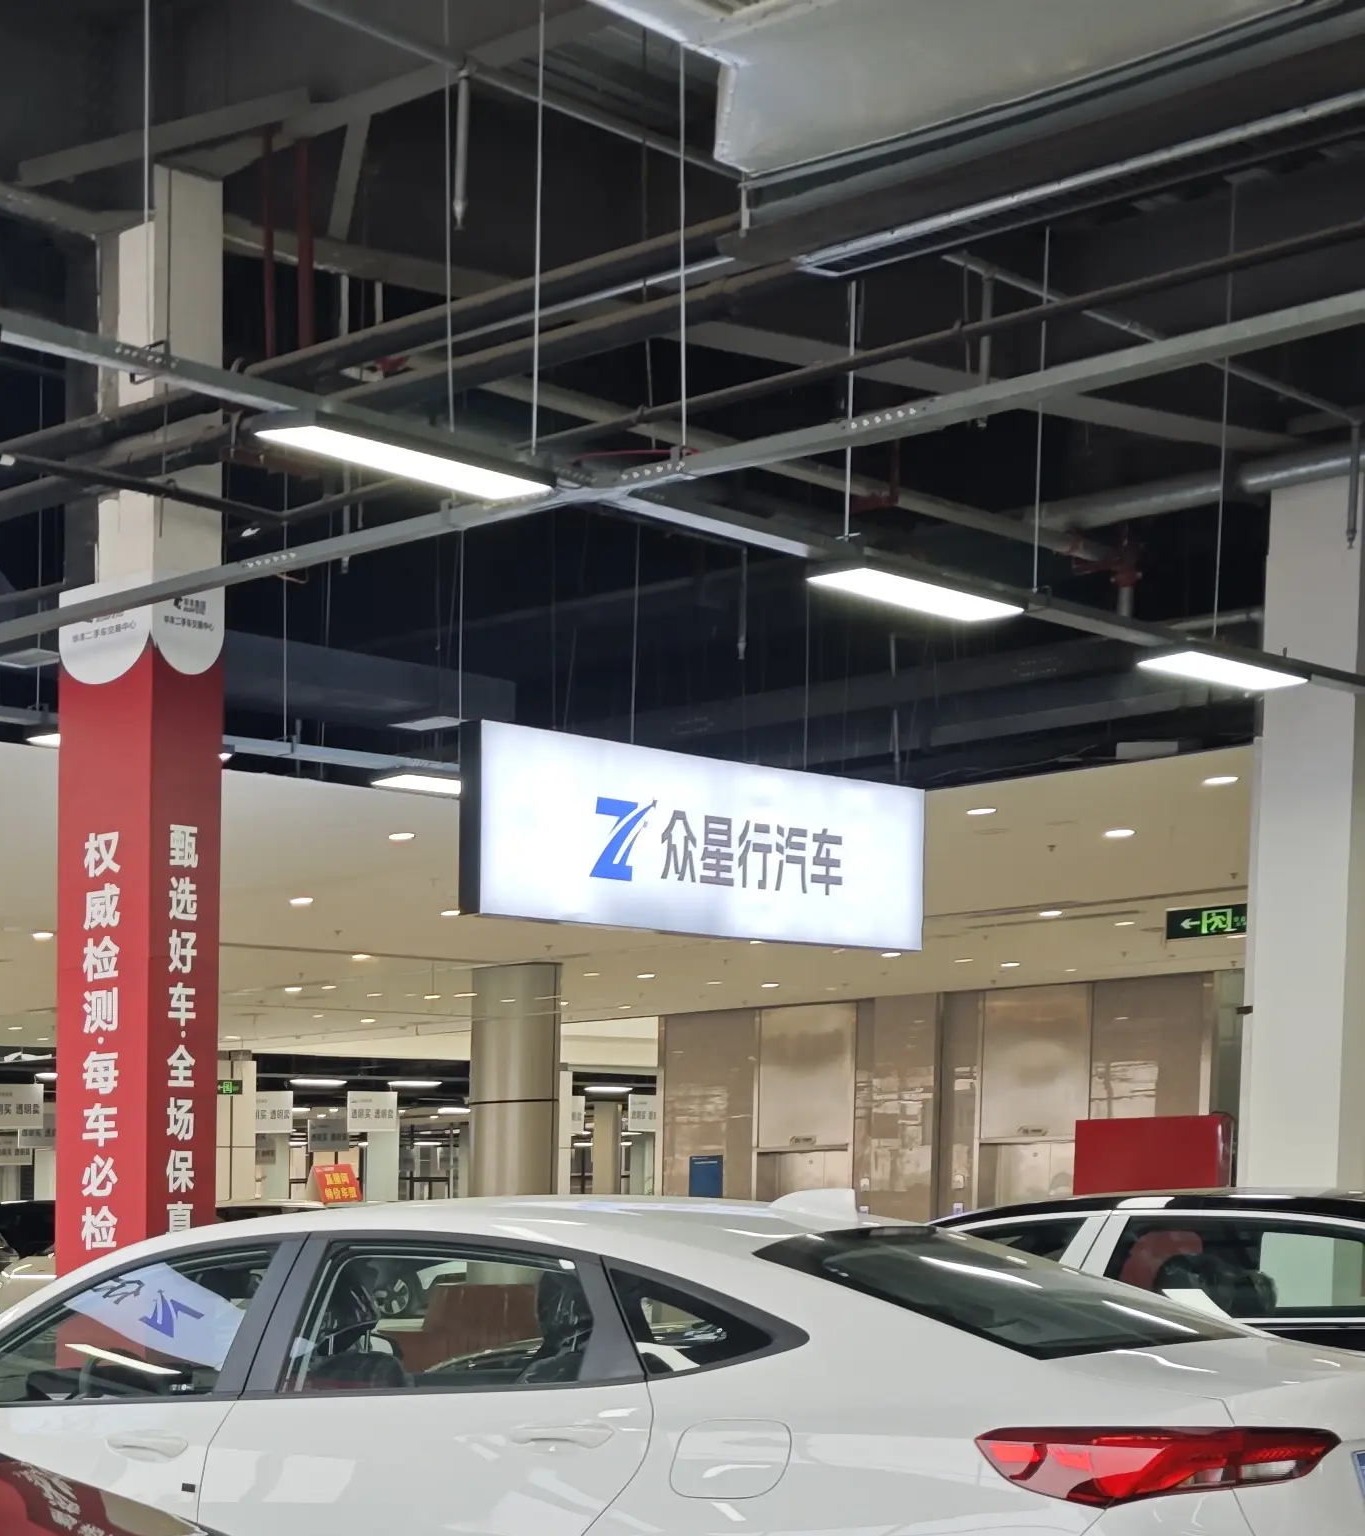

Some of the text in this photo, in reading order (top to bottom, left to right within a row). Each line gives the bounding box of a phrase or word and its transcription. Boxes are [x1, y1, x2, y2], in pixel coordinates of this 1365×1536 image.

[661, 809, 843, 896] 众星行汽车
